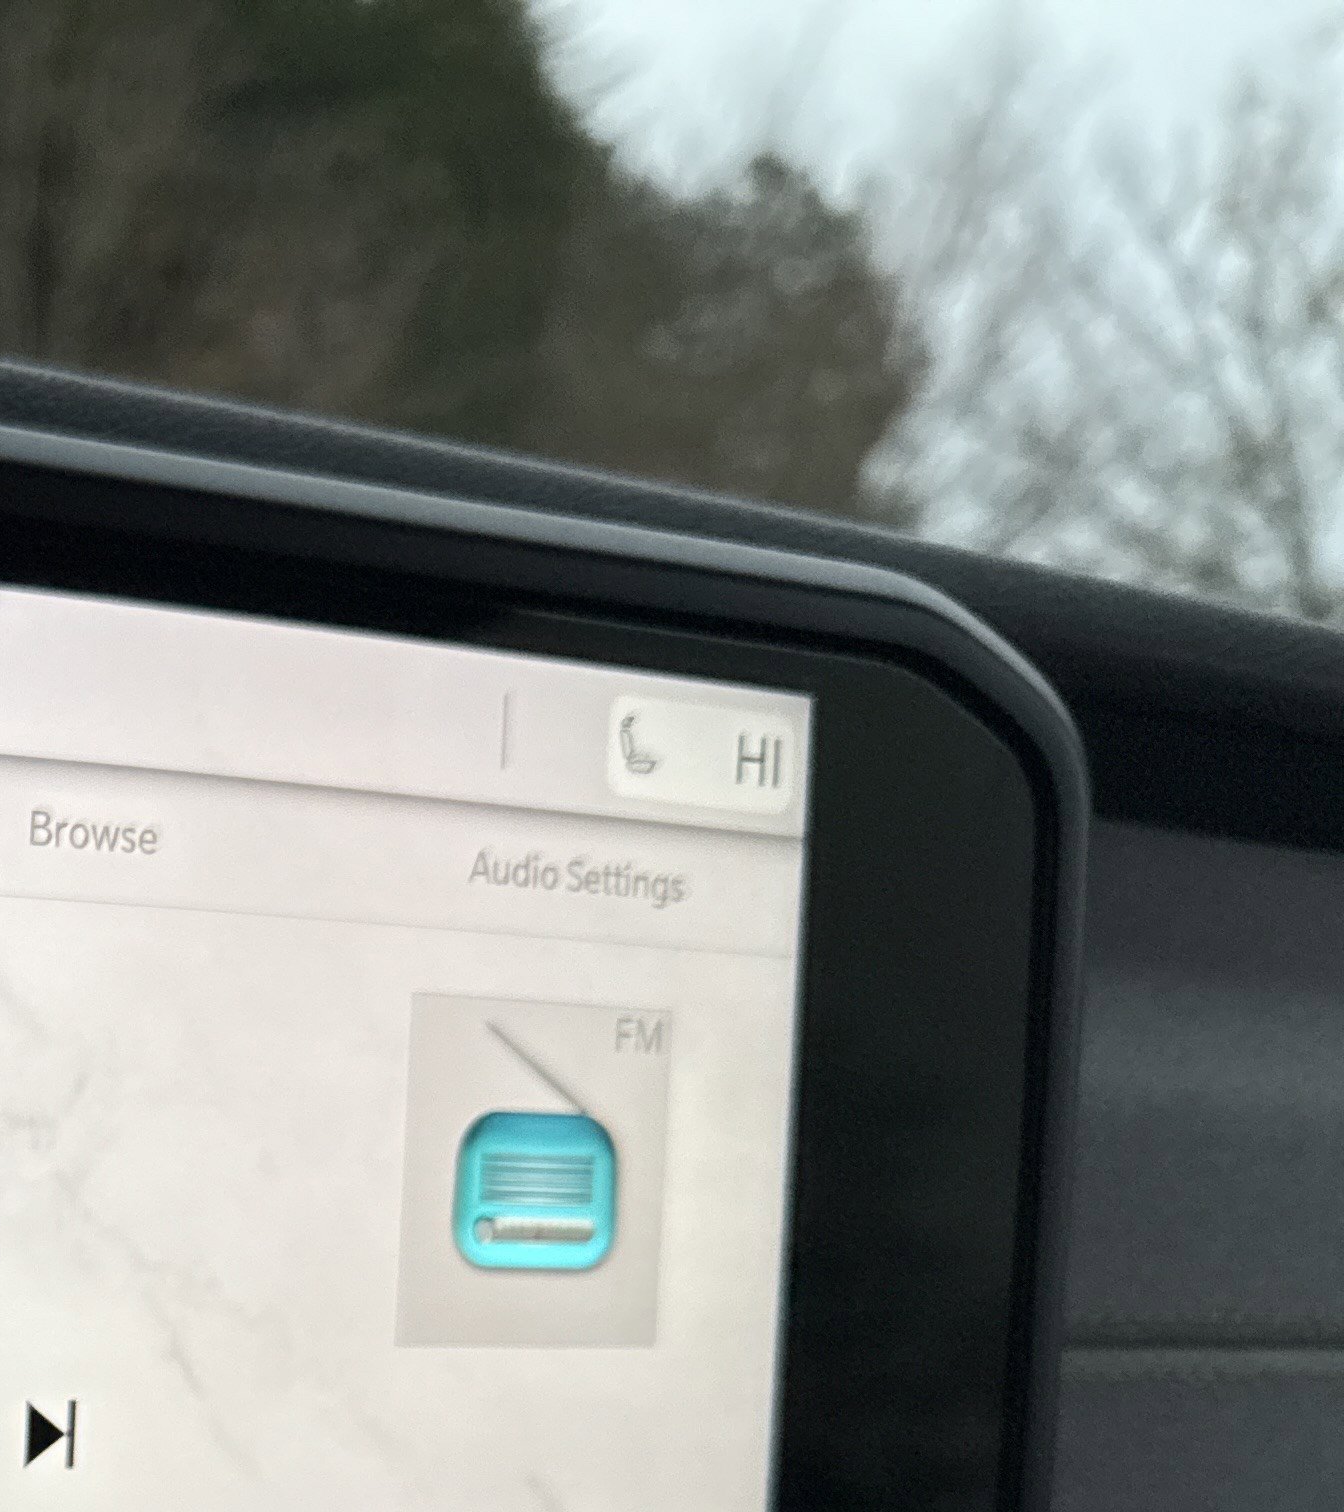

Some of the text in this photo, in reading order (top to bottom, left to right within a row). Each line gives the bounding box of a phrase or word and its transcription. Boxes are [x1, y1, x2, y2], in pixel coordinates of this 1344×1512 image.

[735, 732, 783, 788] HI
[29, 808, 160, 857] Browse
[468, 848, 688, 910] Audio Settings
[614, 1017, 664, 1054] FM
